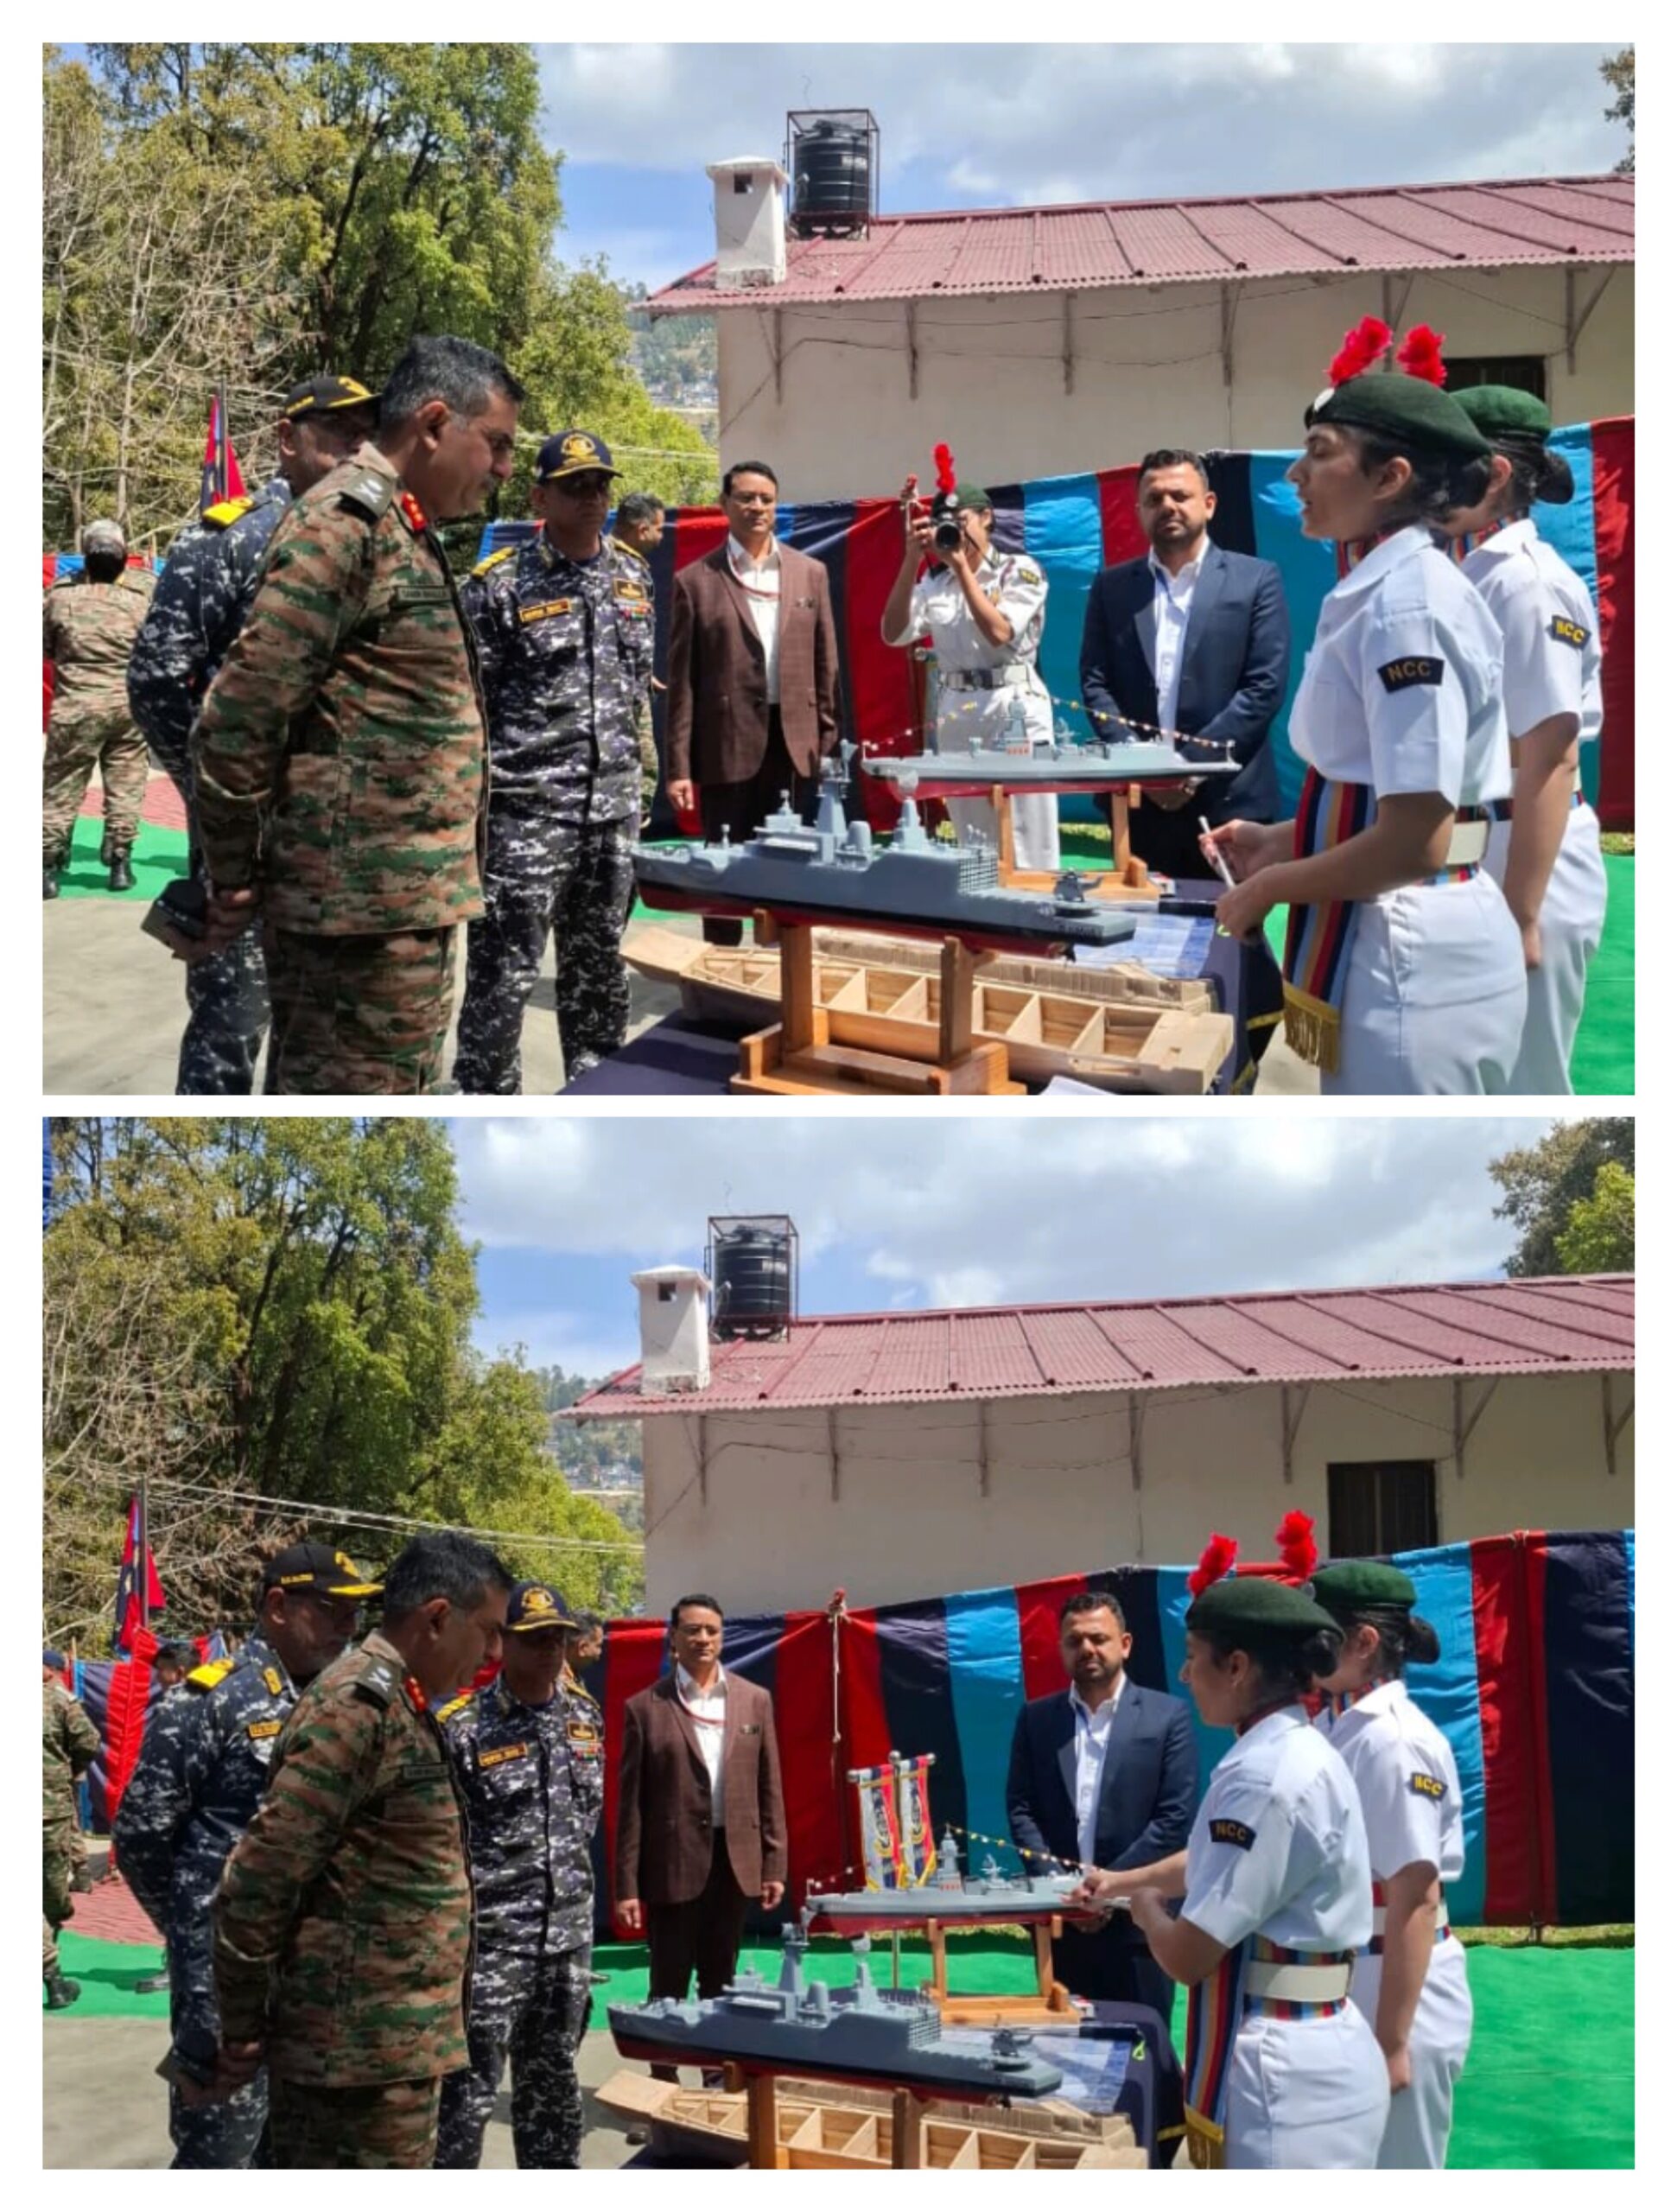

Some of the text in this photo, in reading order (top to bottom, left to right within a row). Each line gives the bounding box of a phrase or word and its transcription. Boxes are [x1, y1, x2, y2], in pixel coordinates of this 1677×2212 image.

[1556, 620, 1585, 644] NCC
[1386, 660, 1432, 683] NCC
[1414, 1775, 1443, 1796] NCC
[1216, 1822, 1247, 1841] NCC
